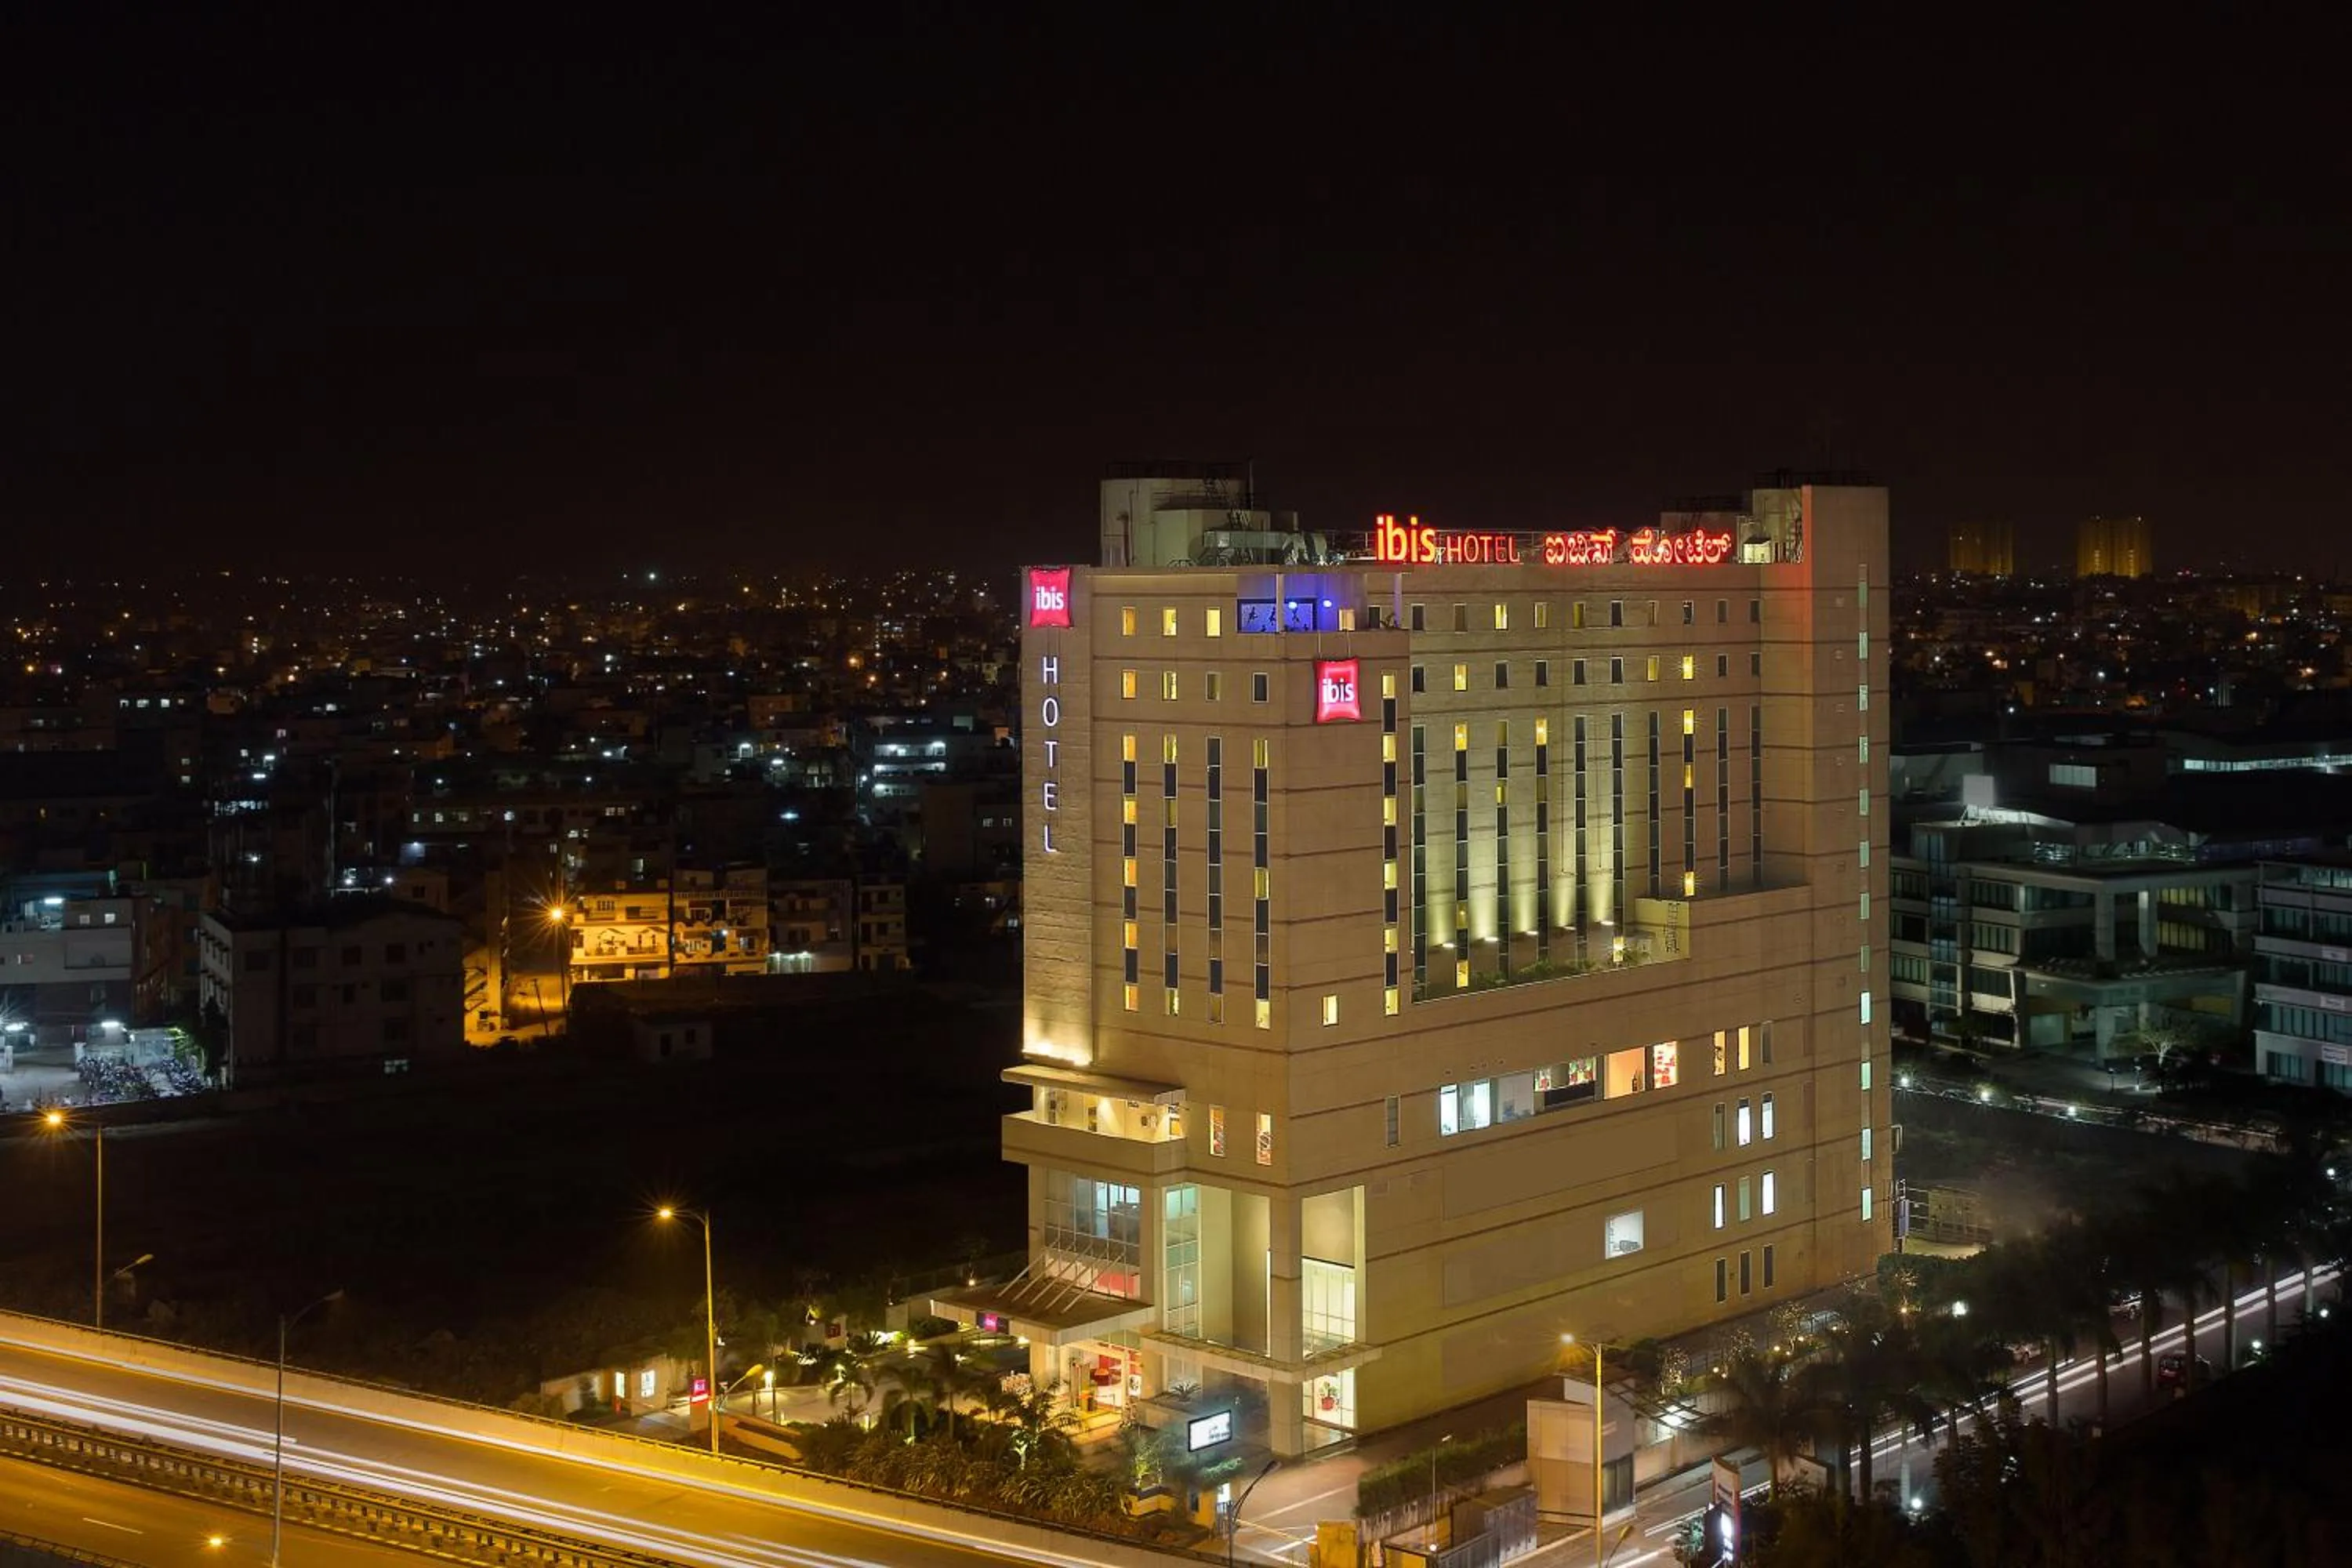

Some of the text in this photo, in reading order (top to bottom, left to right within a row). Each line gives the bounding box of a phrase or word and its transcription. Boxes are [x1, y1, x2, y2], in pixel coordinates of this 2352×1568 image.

[1377, 516, 1521, 562] ibis HOTEL
[1036, 586, 1064, 610] ibis
[1322, 677, 1355, 702] ibis
[1043, 656, 1058, 852] HOTEL
